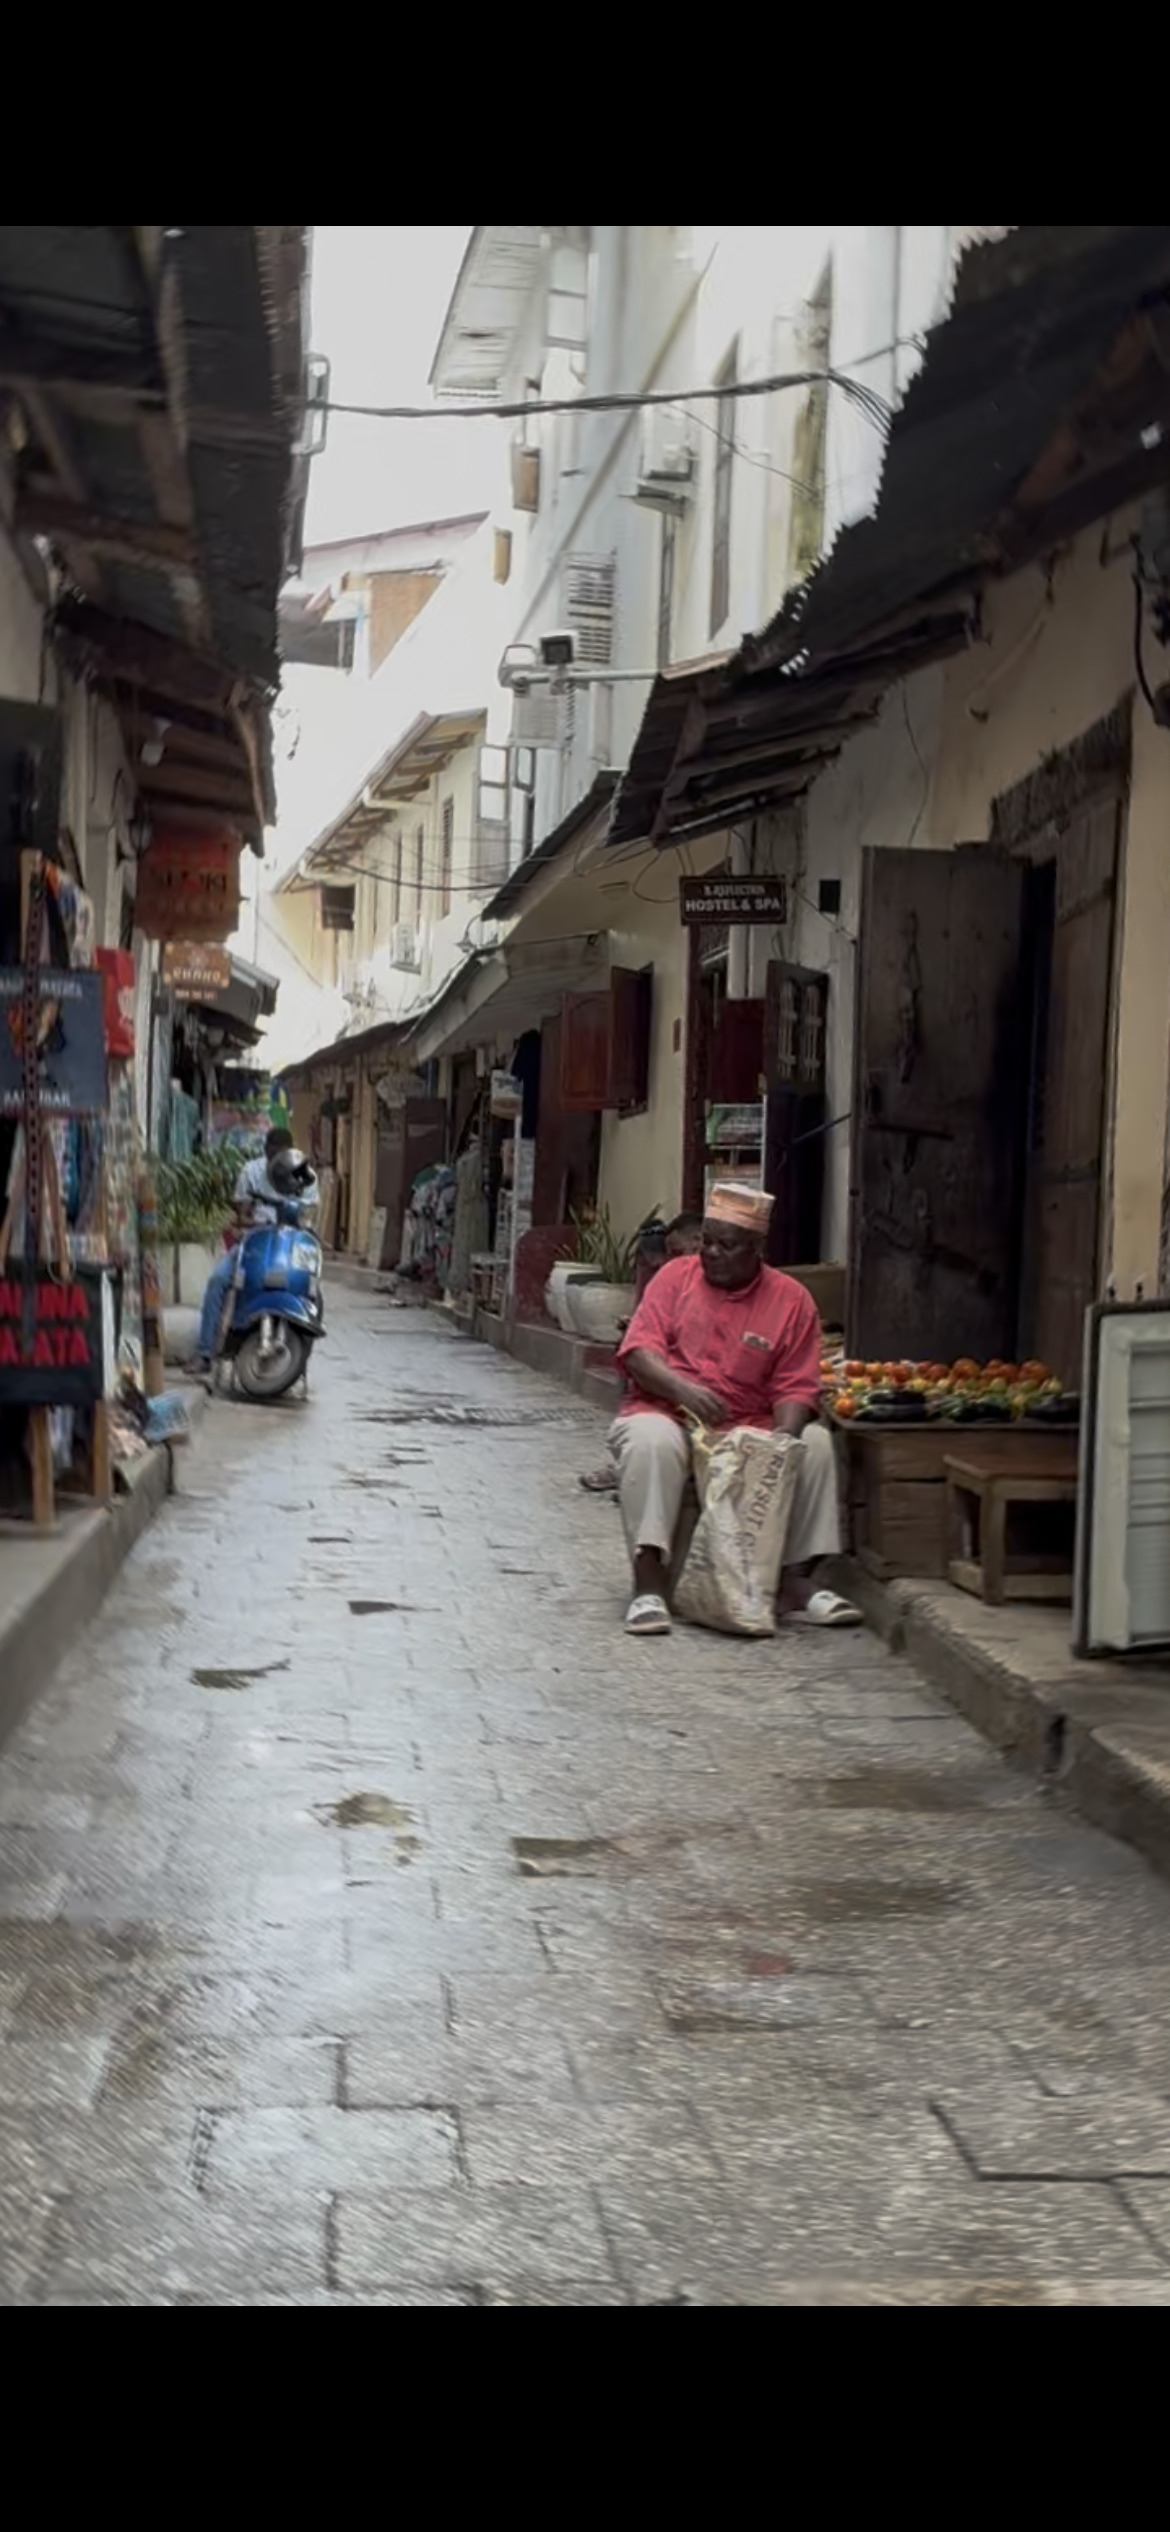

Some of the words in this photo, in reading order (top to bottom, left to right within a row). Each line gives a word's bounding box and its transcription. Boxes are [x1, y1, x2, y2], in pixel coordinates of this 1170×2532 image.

[685, 898, 739, 912] HOSTEL
[741, 898, 751, 911] &
[755, 896, 780, 910] SPA
[745, 1454, 785, 1530] RAYSUT
